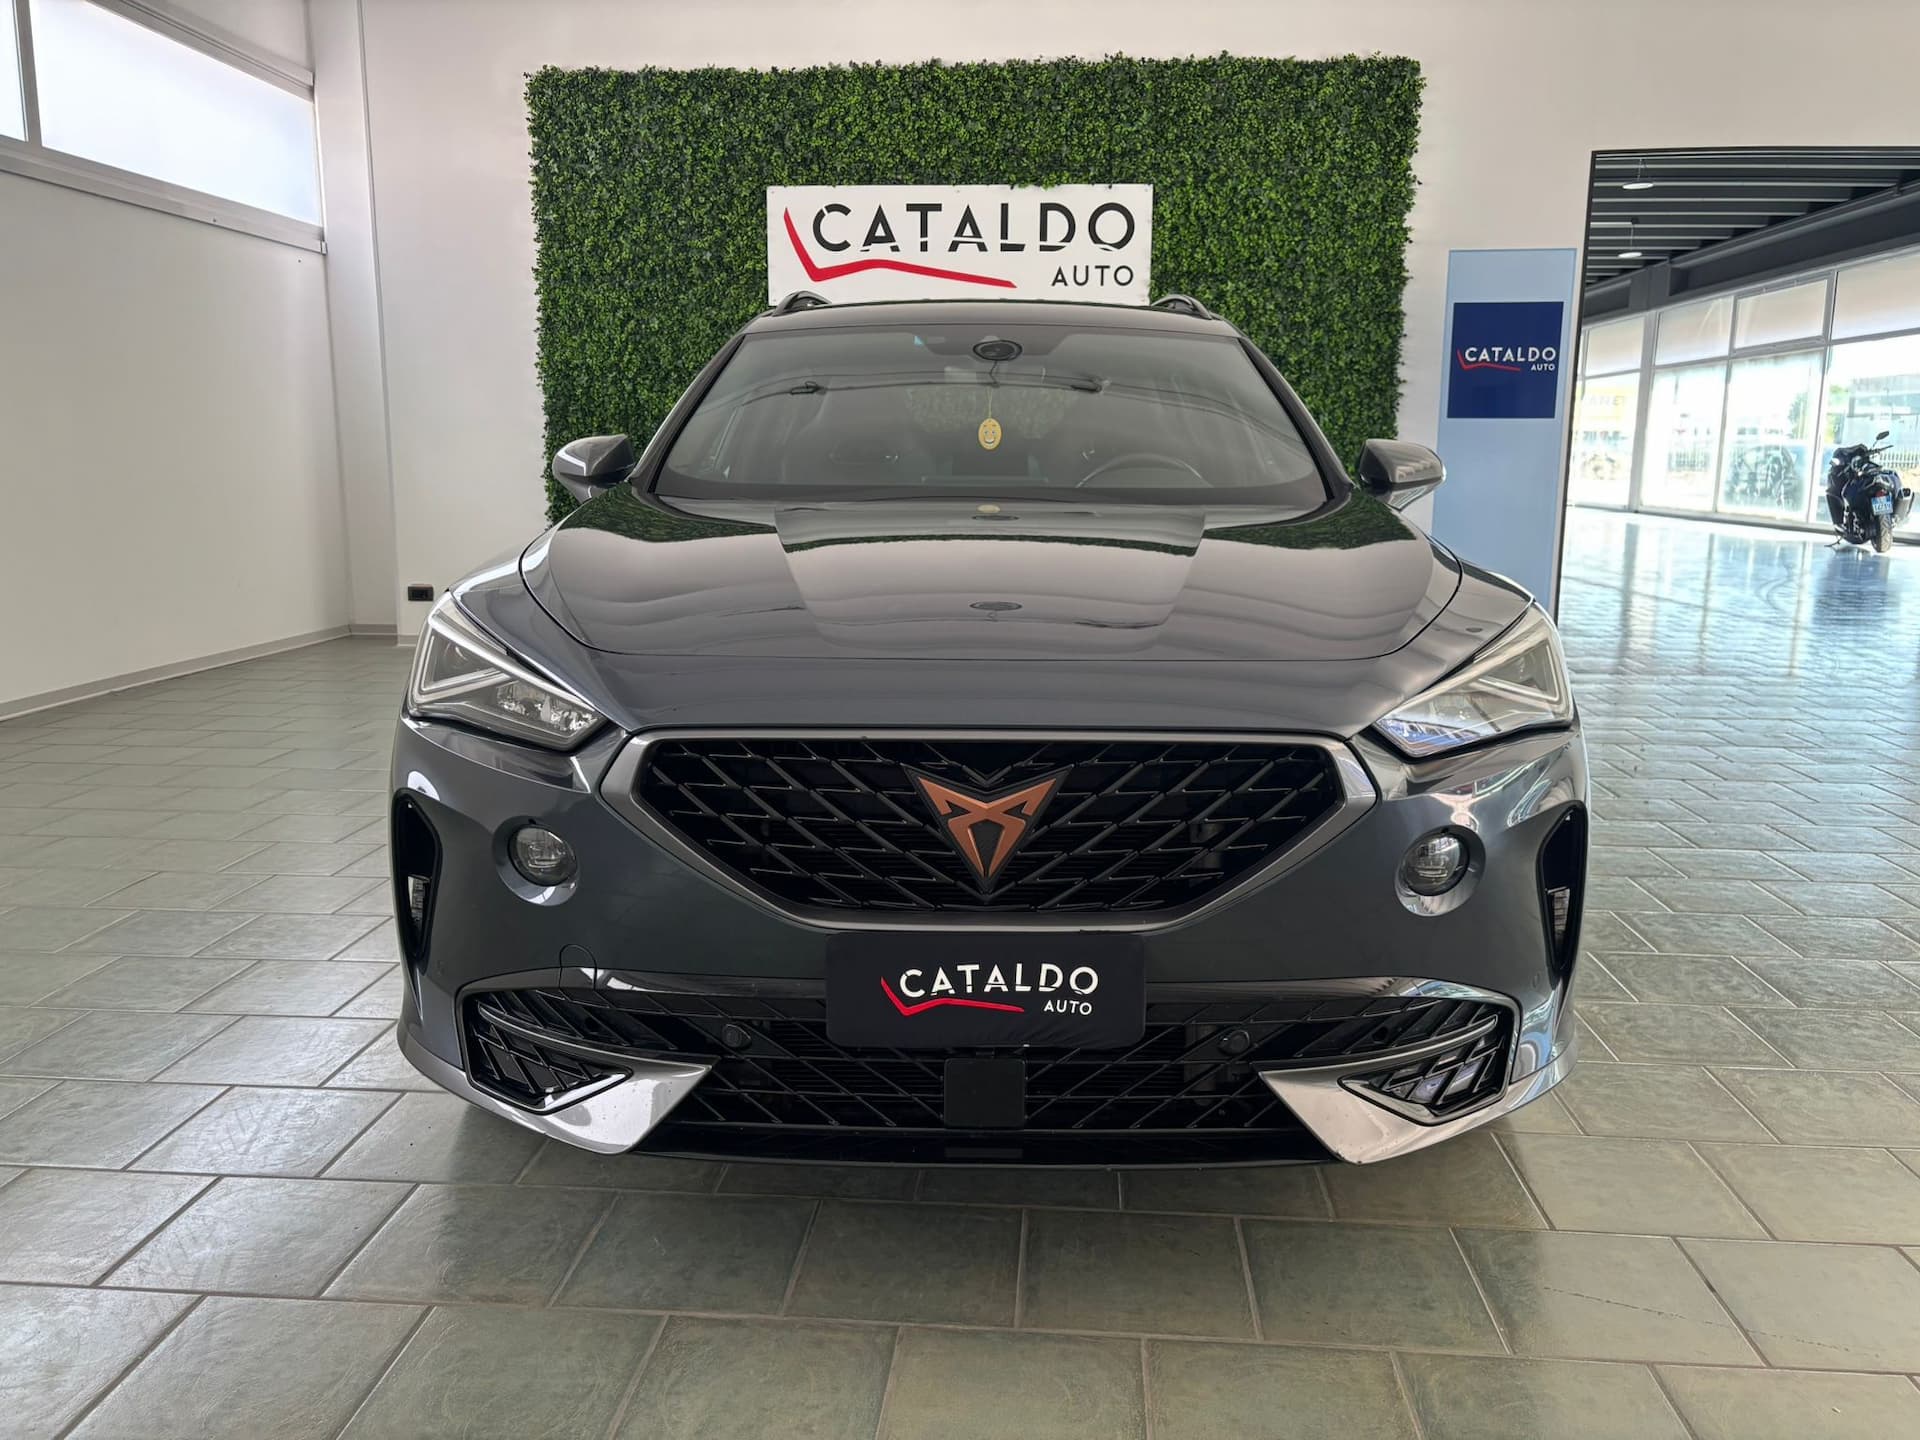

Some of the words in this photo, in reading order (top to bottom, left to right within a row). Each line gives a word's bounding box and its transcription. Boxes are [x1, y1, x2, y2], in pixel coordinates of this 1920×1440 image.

[812, 202, 1136, 252] CATALDO
[1051, 265, 1134, 286] AUTO
[1464, 347, 1557, 362] CATALDO
[1530, 363, 1556, 371] AUTO
[899, 963, 1099, 998] CATALDO
[1043, 1000, 1093, 1015] AUTO
